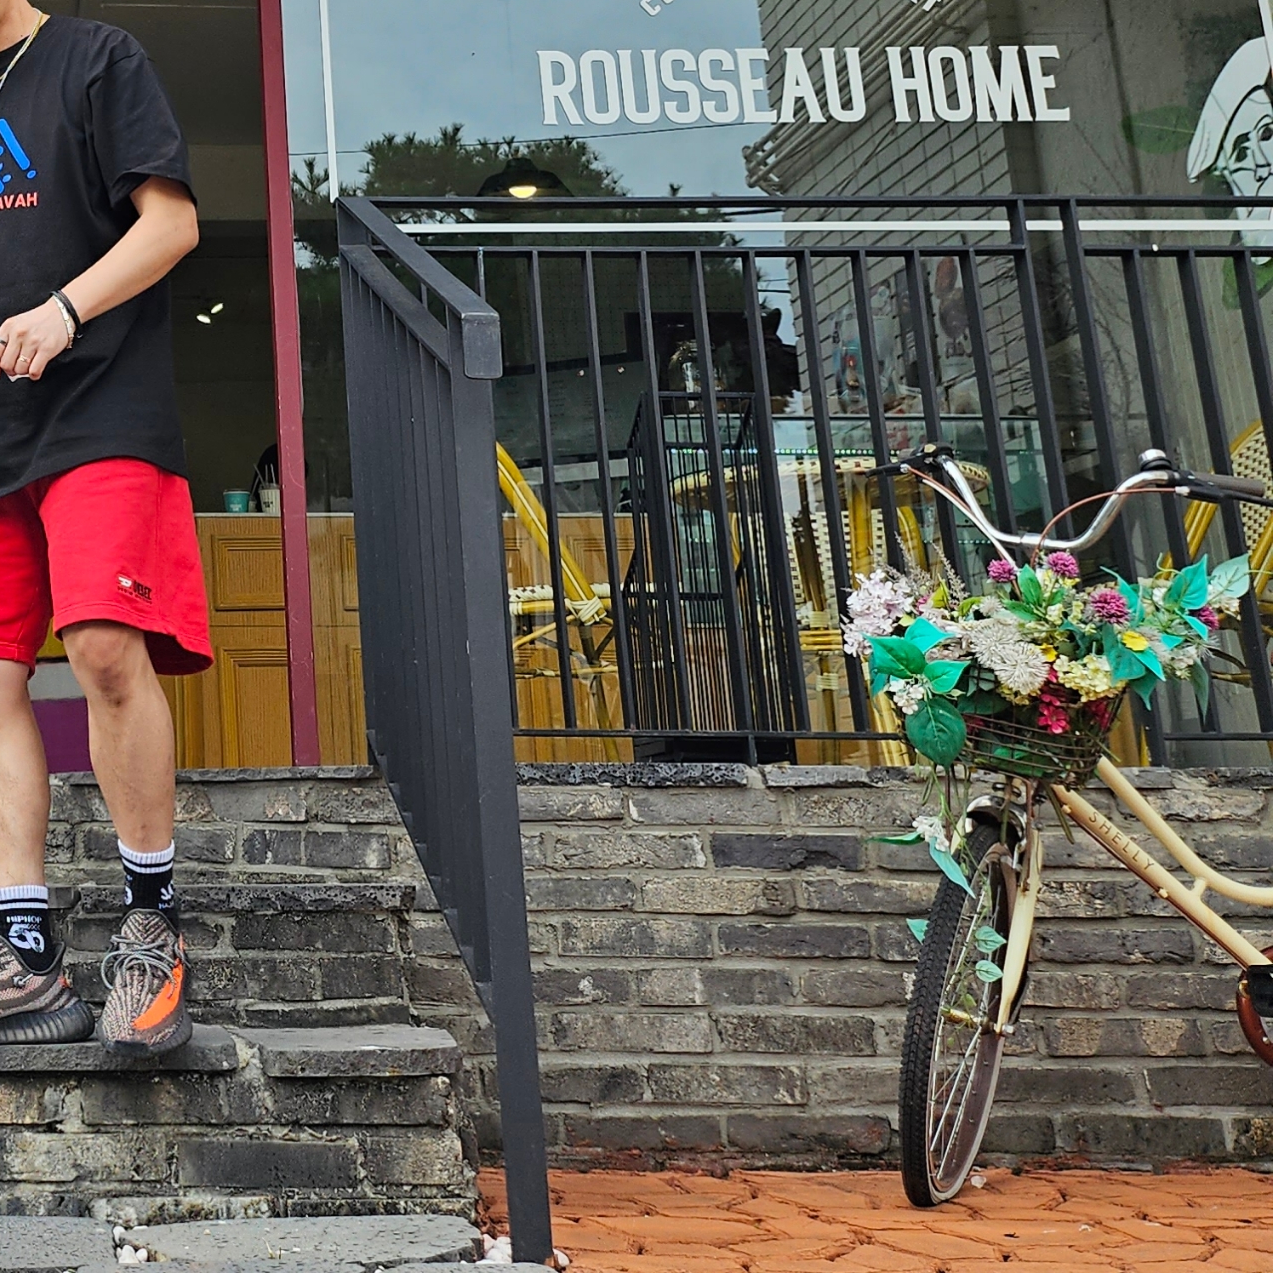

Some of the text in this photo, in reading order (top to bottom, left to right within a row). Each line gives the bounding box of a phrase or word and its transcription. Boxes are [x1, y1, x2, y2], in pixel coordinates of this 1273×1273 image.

[536, 44, 1071, 126] ROUSSEAU HOME
[1088, 811, 1155, 870] SHELLY
